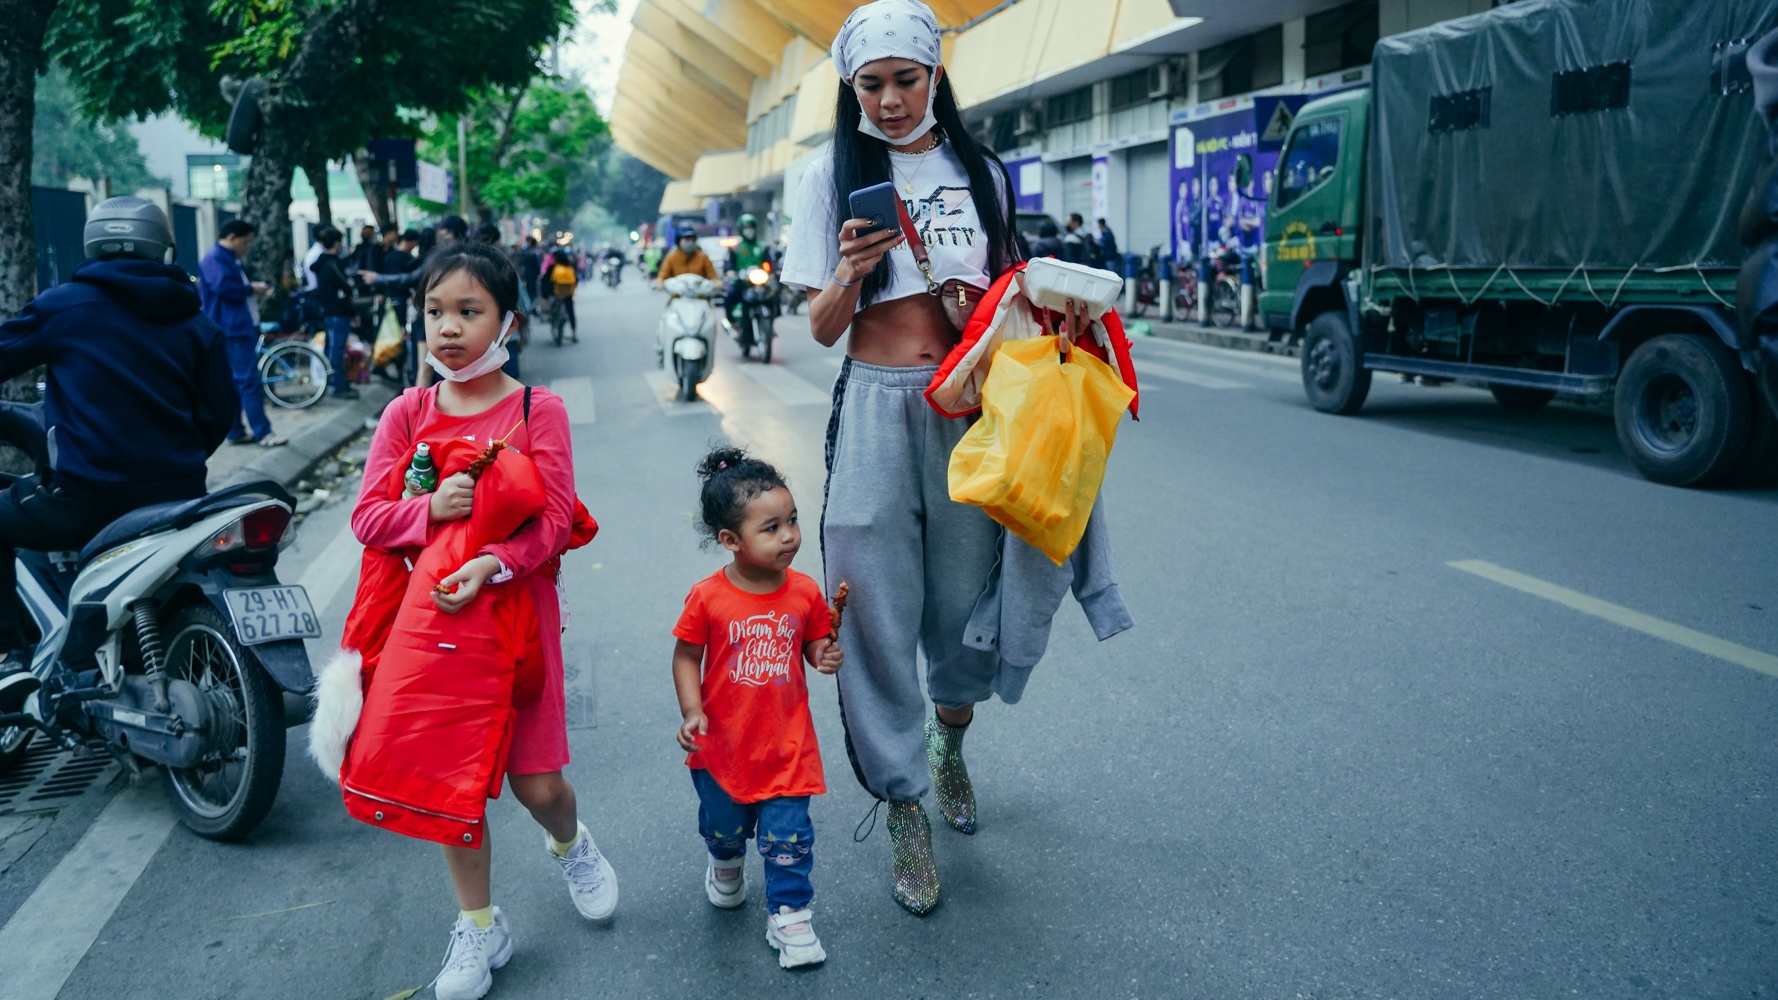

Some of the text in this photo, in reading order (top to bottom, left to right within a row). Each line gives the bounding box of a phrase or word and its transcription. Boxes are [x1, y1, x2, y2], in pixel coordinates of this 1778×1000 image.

[239, 589, 299, 613] 29-H1
[242, 612, 315, 639] 627.28
[729, 614, 795, 646] Dream big
[745, 638, 778, 660] little
[729, 651, 792, 683] Mermaid
